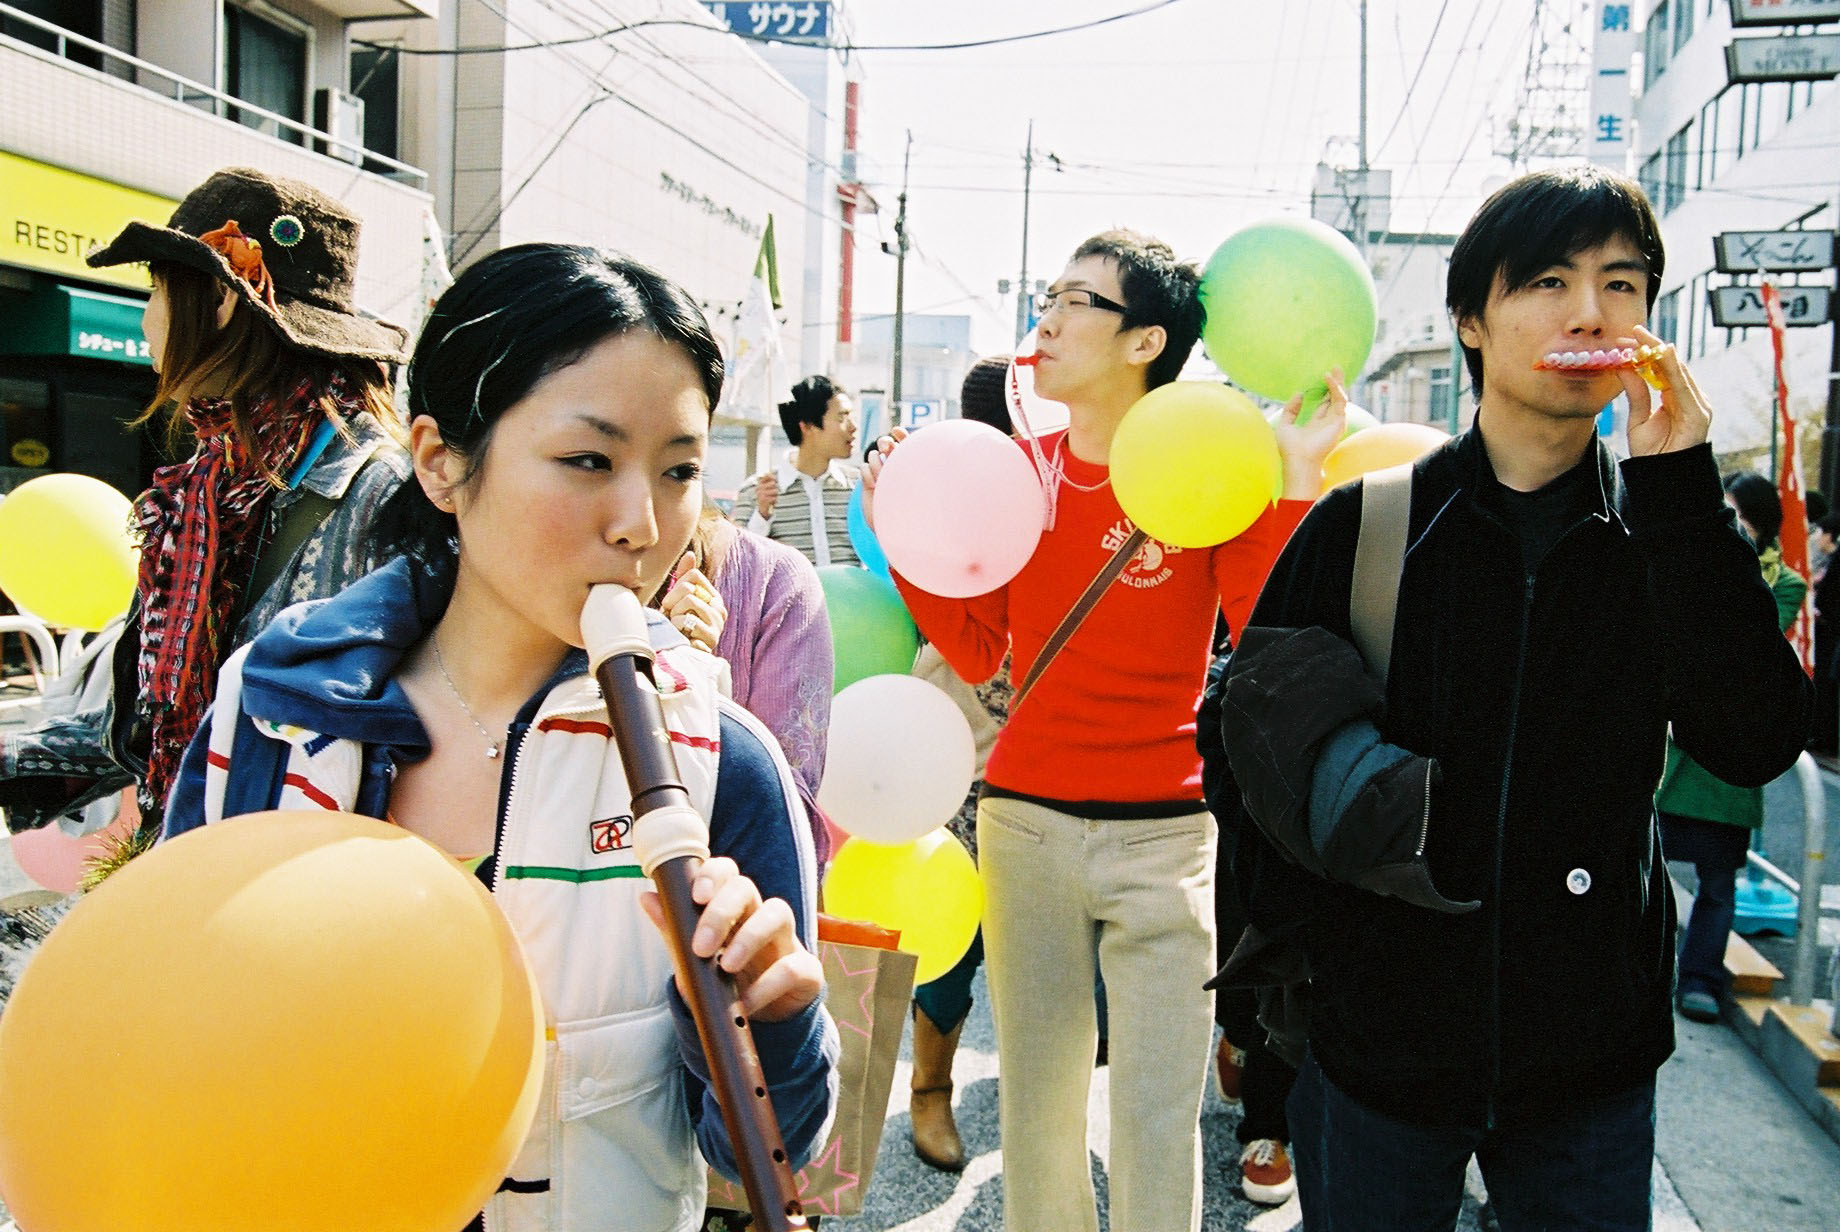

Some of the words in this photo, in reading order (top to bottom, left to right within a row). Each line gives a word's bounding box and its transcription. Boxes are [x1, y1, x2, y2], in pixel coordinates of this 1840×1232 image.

[748, 3, 820, 34] サウナ
[16, 220, 106, 257] RESTA
[911, 403, 930, 425] P
